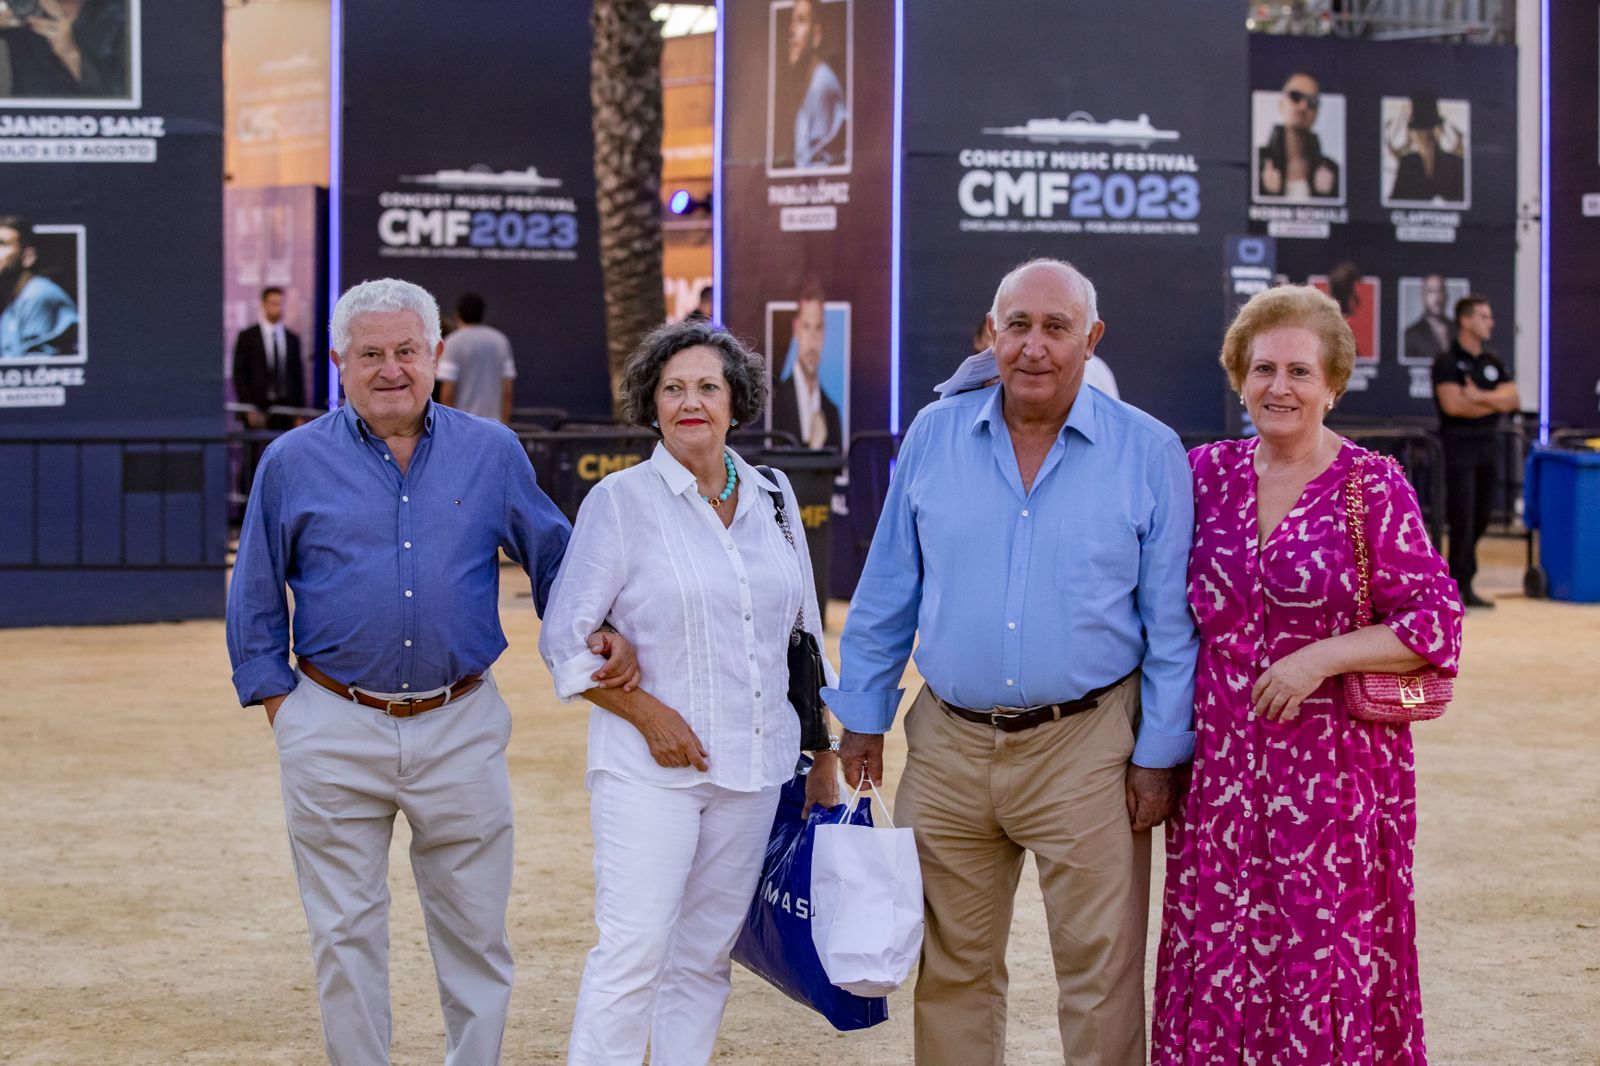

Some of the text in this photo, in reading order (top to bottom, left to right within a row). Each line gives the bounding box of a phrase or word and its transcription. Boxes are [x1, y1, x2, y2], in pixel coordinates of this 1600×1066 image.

[100, 115, 165, 138] SANZ
[81, 144, 151, 156] AGOSTO
[958, 149, 1198, 172] CONCERT MUSIC FESTIVAL
[378, 191, 577, 213] CONCERT MUSIC FESTIVAL
[23, 364, 86, 386] LÓPEZ
